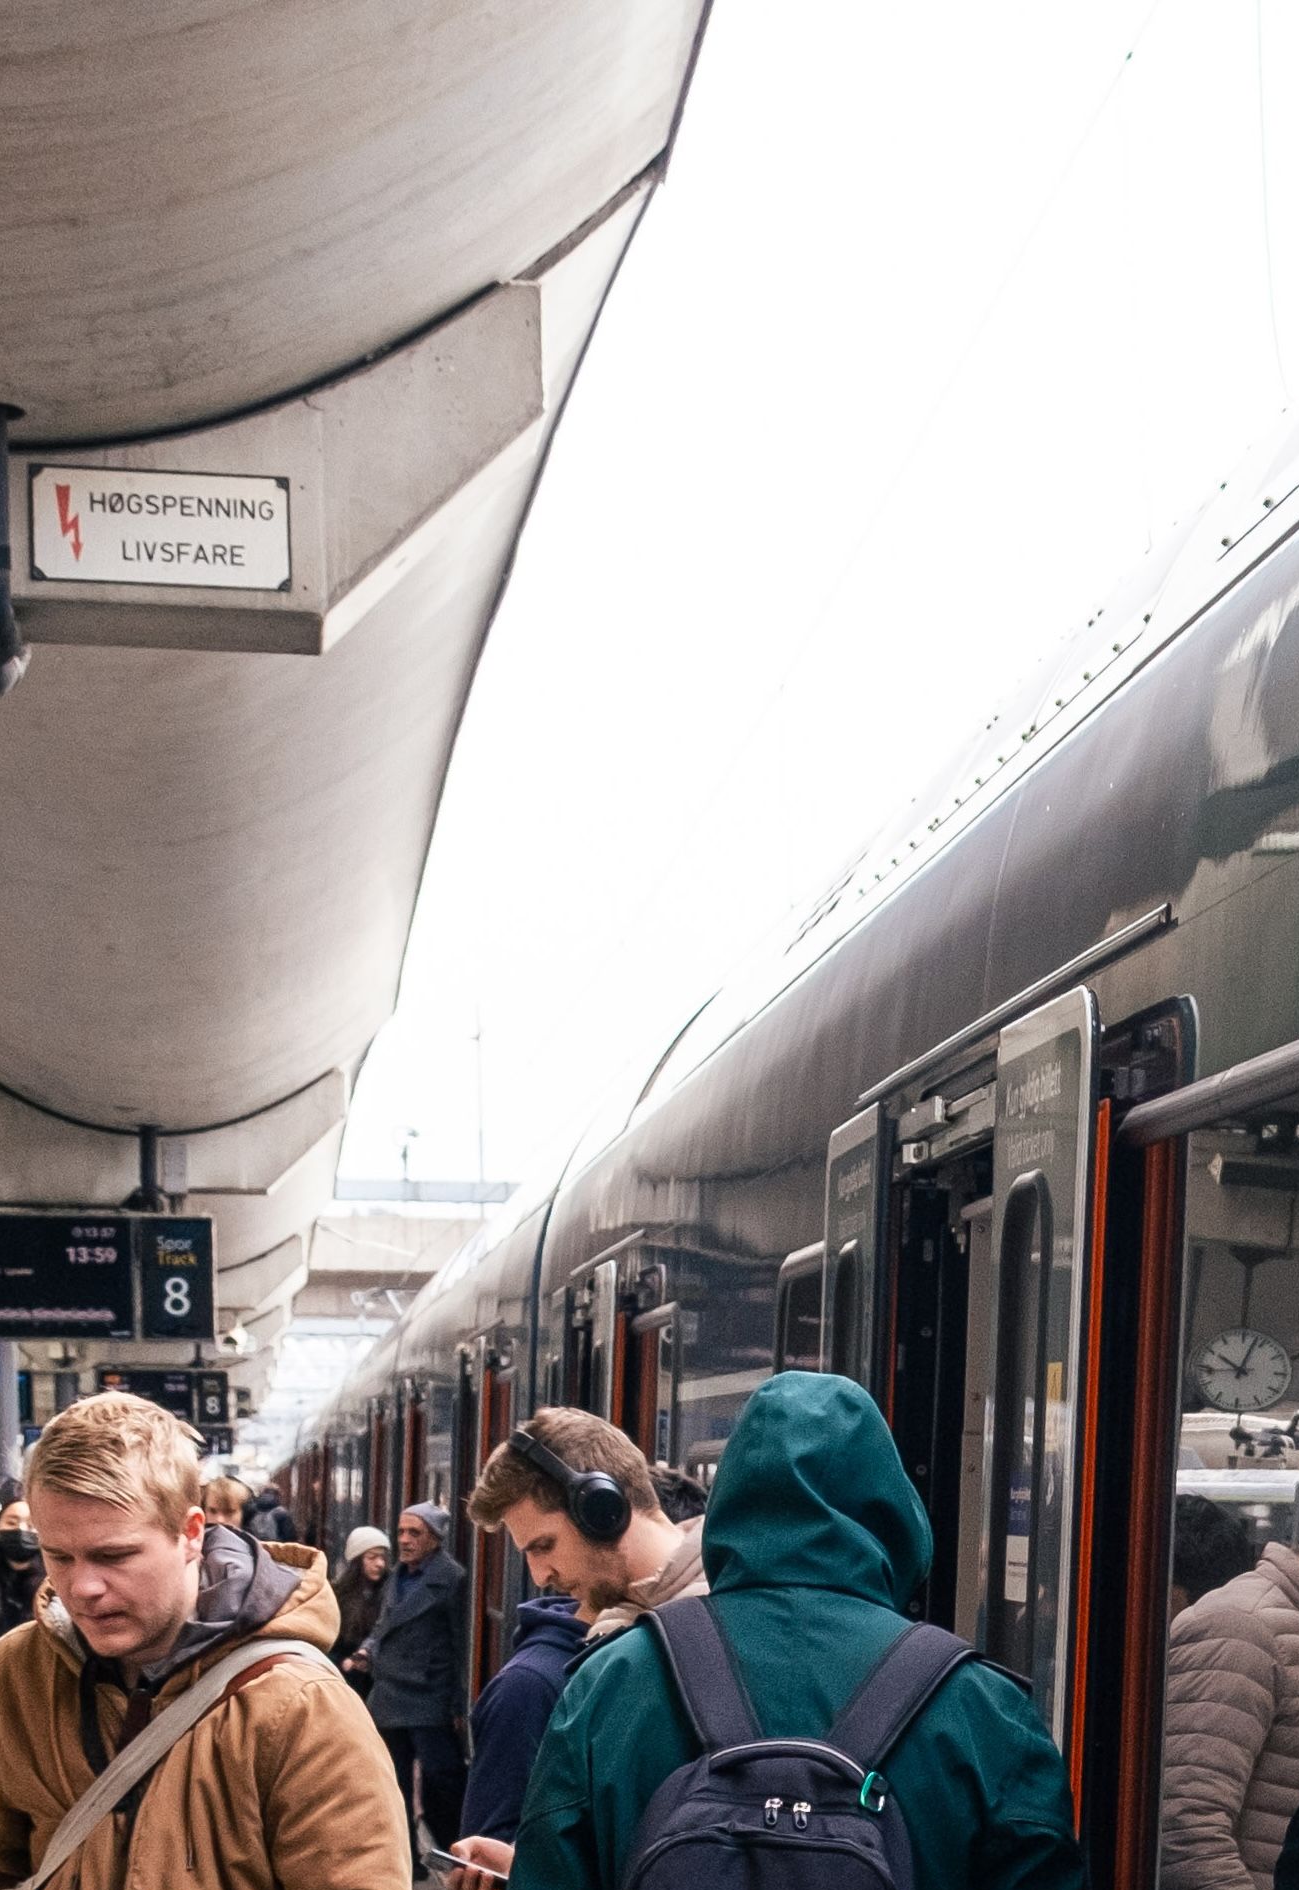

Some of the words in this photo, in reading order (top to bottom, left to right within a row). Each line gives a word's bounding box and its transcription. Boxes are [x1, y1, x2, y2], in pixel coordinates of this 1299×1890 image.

[89, 492, 275, 522] HØGSPENNING
[121, 540, 246, 567] LIVSFARE
[65, 1246, 118, 1264] 13:59
[164, 1277, 192, 1317] 8
[205, 1396, 221, 1416] 8
